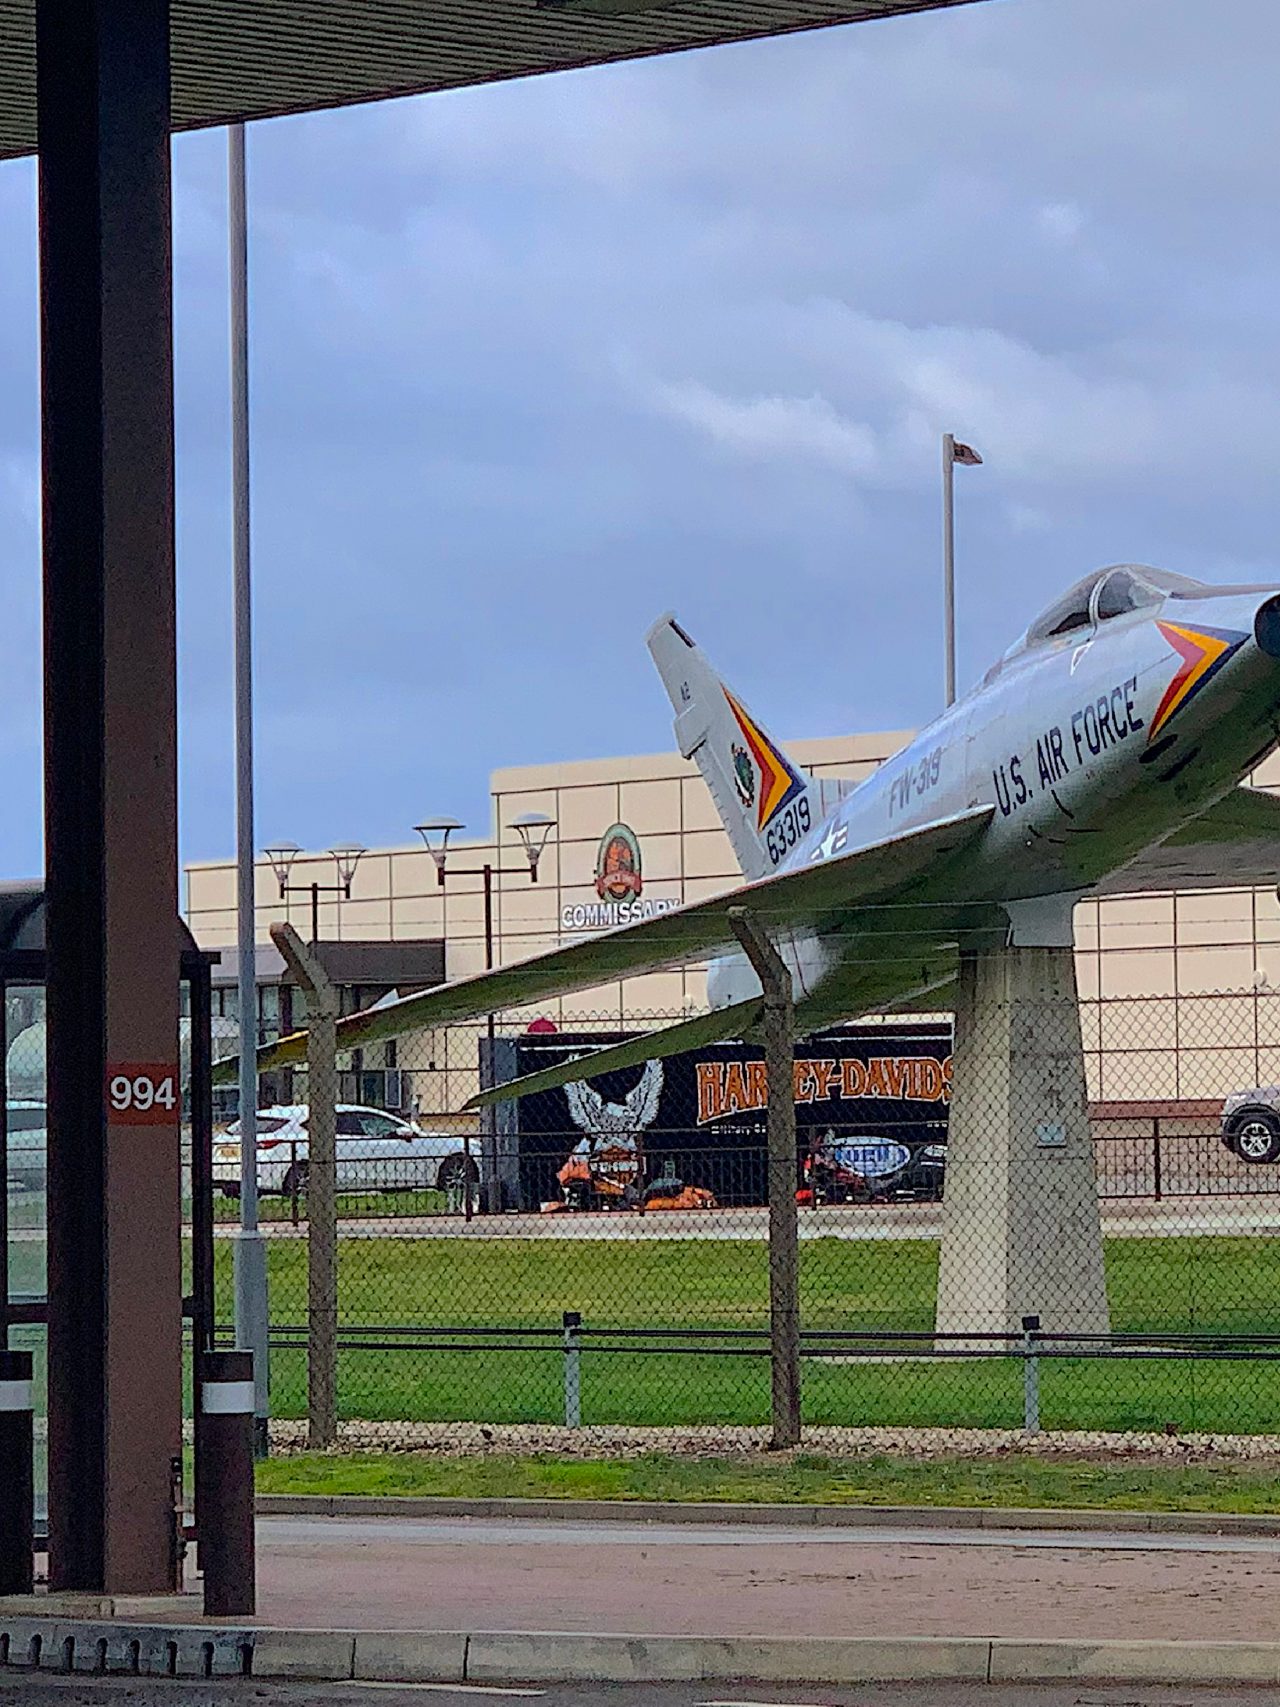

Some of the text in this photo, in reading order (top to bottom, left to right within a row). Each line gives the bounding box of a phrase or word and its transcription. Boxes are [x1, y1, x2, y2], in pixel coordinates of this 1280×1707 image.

[993, 676, 1145, 817] U.S. AIR FORCE
[887, 747, 948, 818] FW-319
[767, 796, 811, 865] 63319
[110, 1076, 176, 1110] 994
